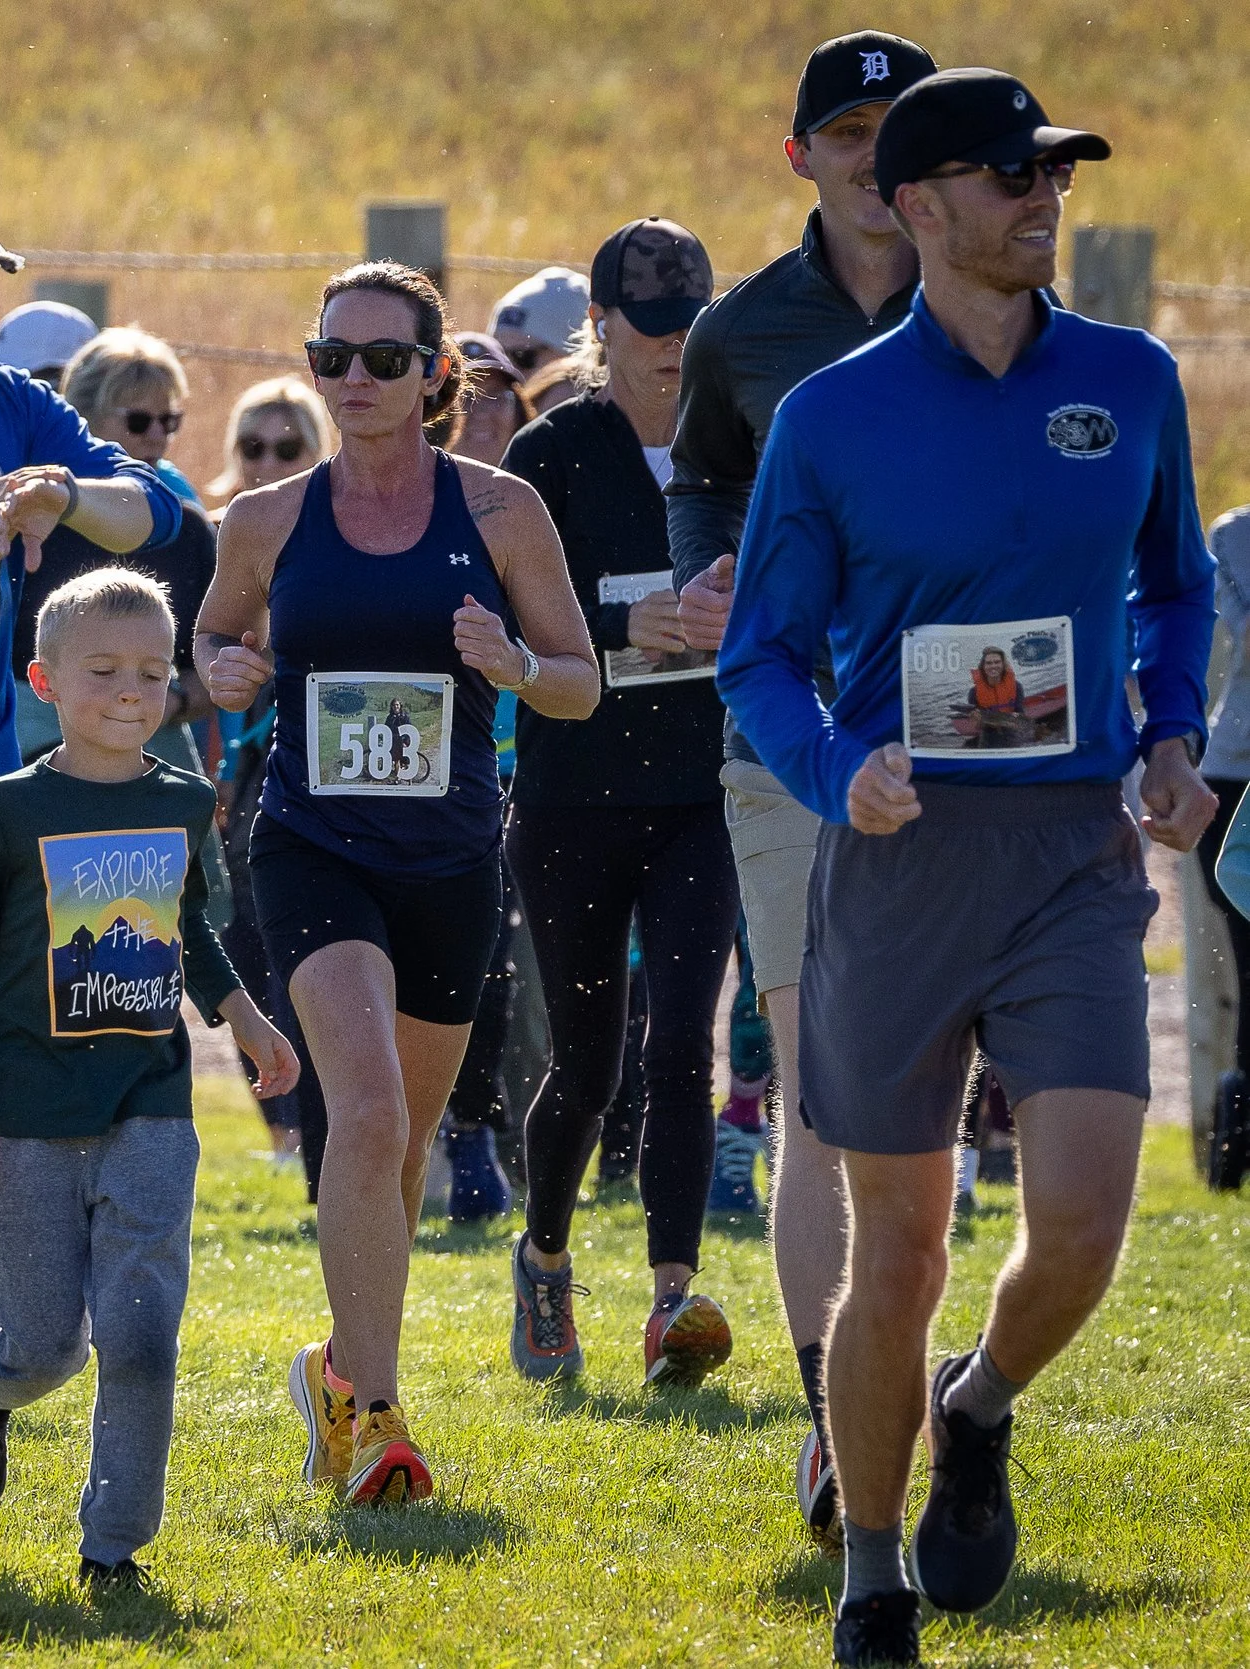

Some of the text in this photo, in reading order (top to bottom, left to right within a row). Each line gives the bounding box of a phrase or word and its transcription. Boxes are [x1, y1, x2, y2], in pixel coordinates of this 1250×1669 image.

[859, 51, 890, 85] D
[913, 641, 962, 673] 686
[339, 723, 421, 780] 583
[72, 847, 173, 899] EXPLORE
[68, 970, 181, 1018] IMPOSSIBLE
